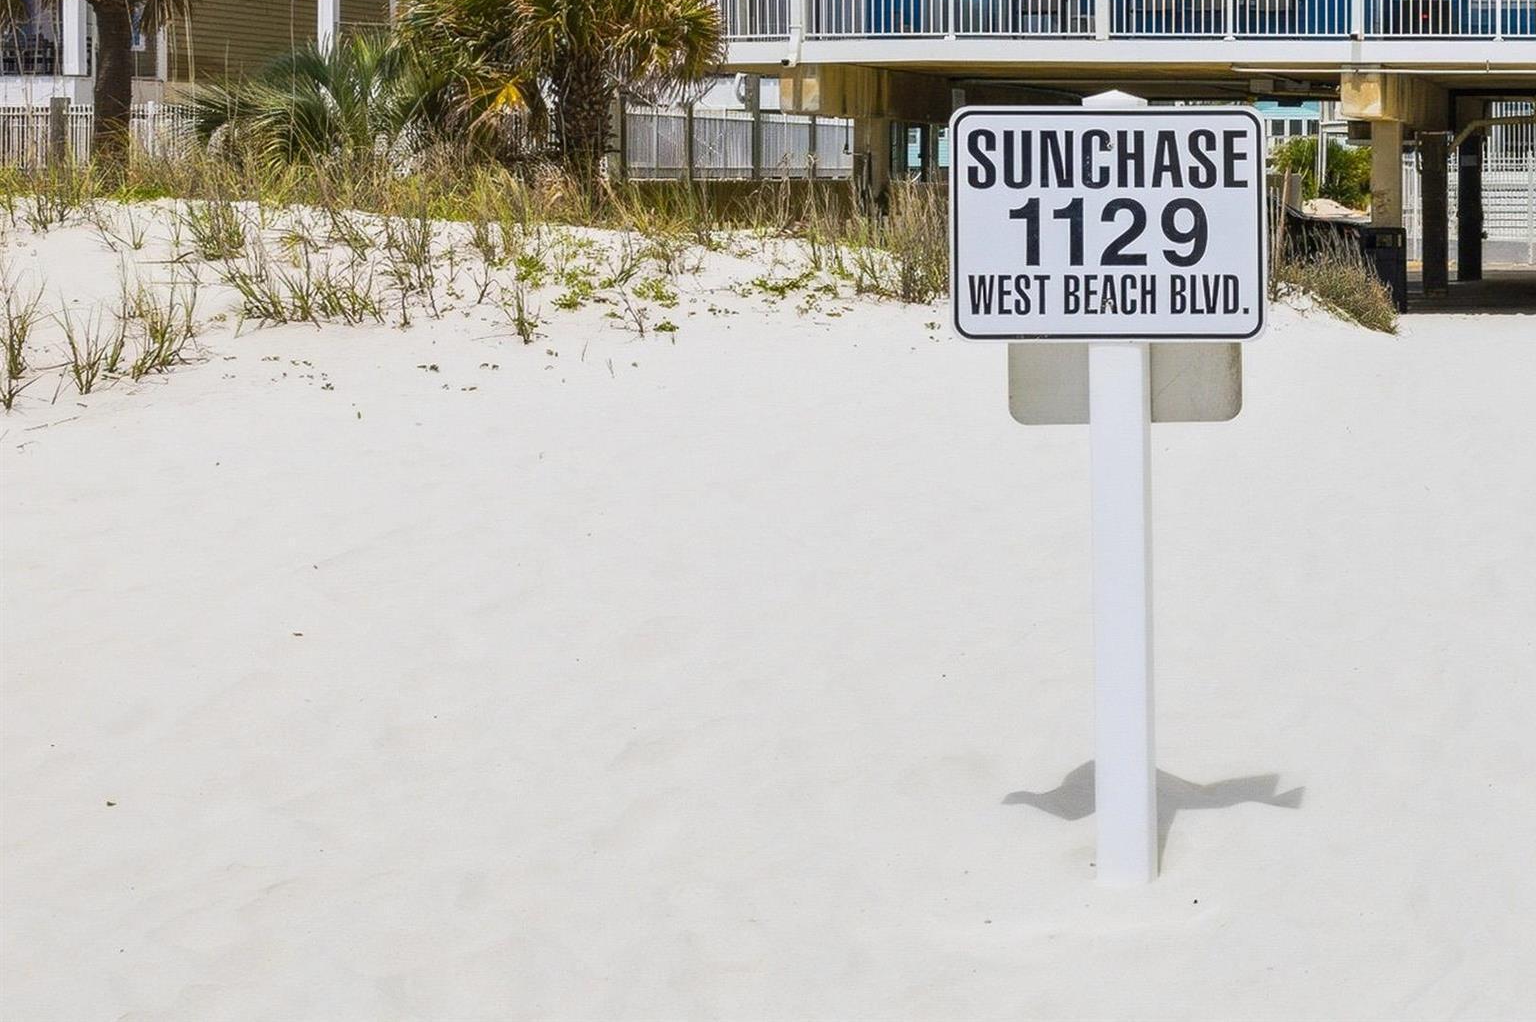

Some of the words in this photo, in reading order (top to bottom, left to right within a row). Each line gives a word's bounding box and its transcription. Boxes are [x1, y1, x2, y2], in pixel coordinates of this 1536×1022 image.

[967, 129, 1249, 189] SUNCHASE
[1009, 197, 1208, 268] 1129
[968, 274, 1051, 315] WEST
[1063, 274, 1156, 314] BEACH
[1170, 274, 1249, 314] BLVD.
